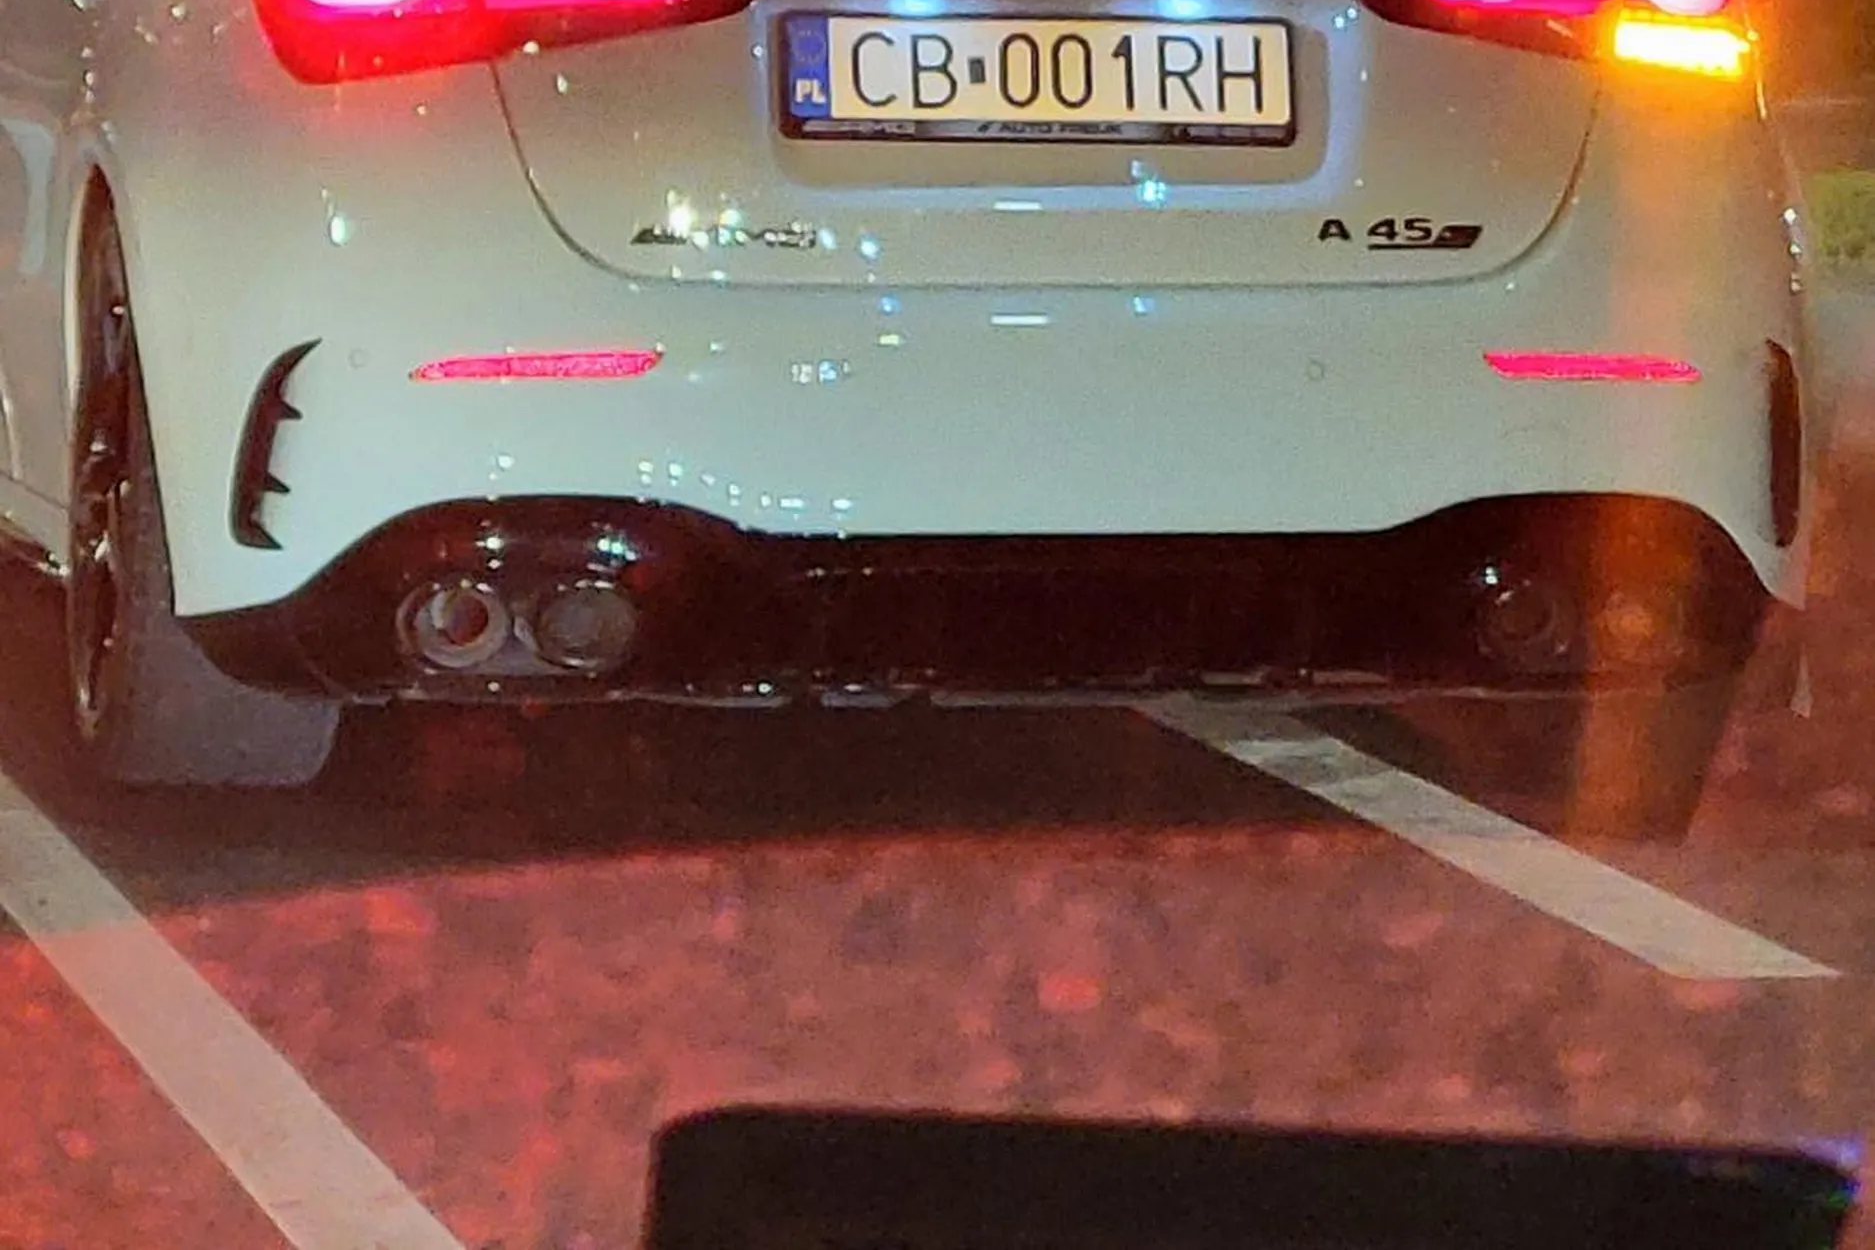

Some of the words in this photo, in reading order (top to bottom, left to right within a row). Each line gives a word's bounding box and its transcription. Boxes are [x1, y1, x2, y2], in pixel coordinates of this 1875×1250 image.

[851, 31, 957, 109] CB
[1000, 31, 1263, 114] 001RH
[795, 78, 827, 103] PL
[999, 121, 1051, 134] AUTO
[1318, 219, 1351, 241] A
